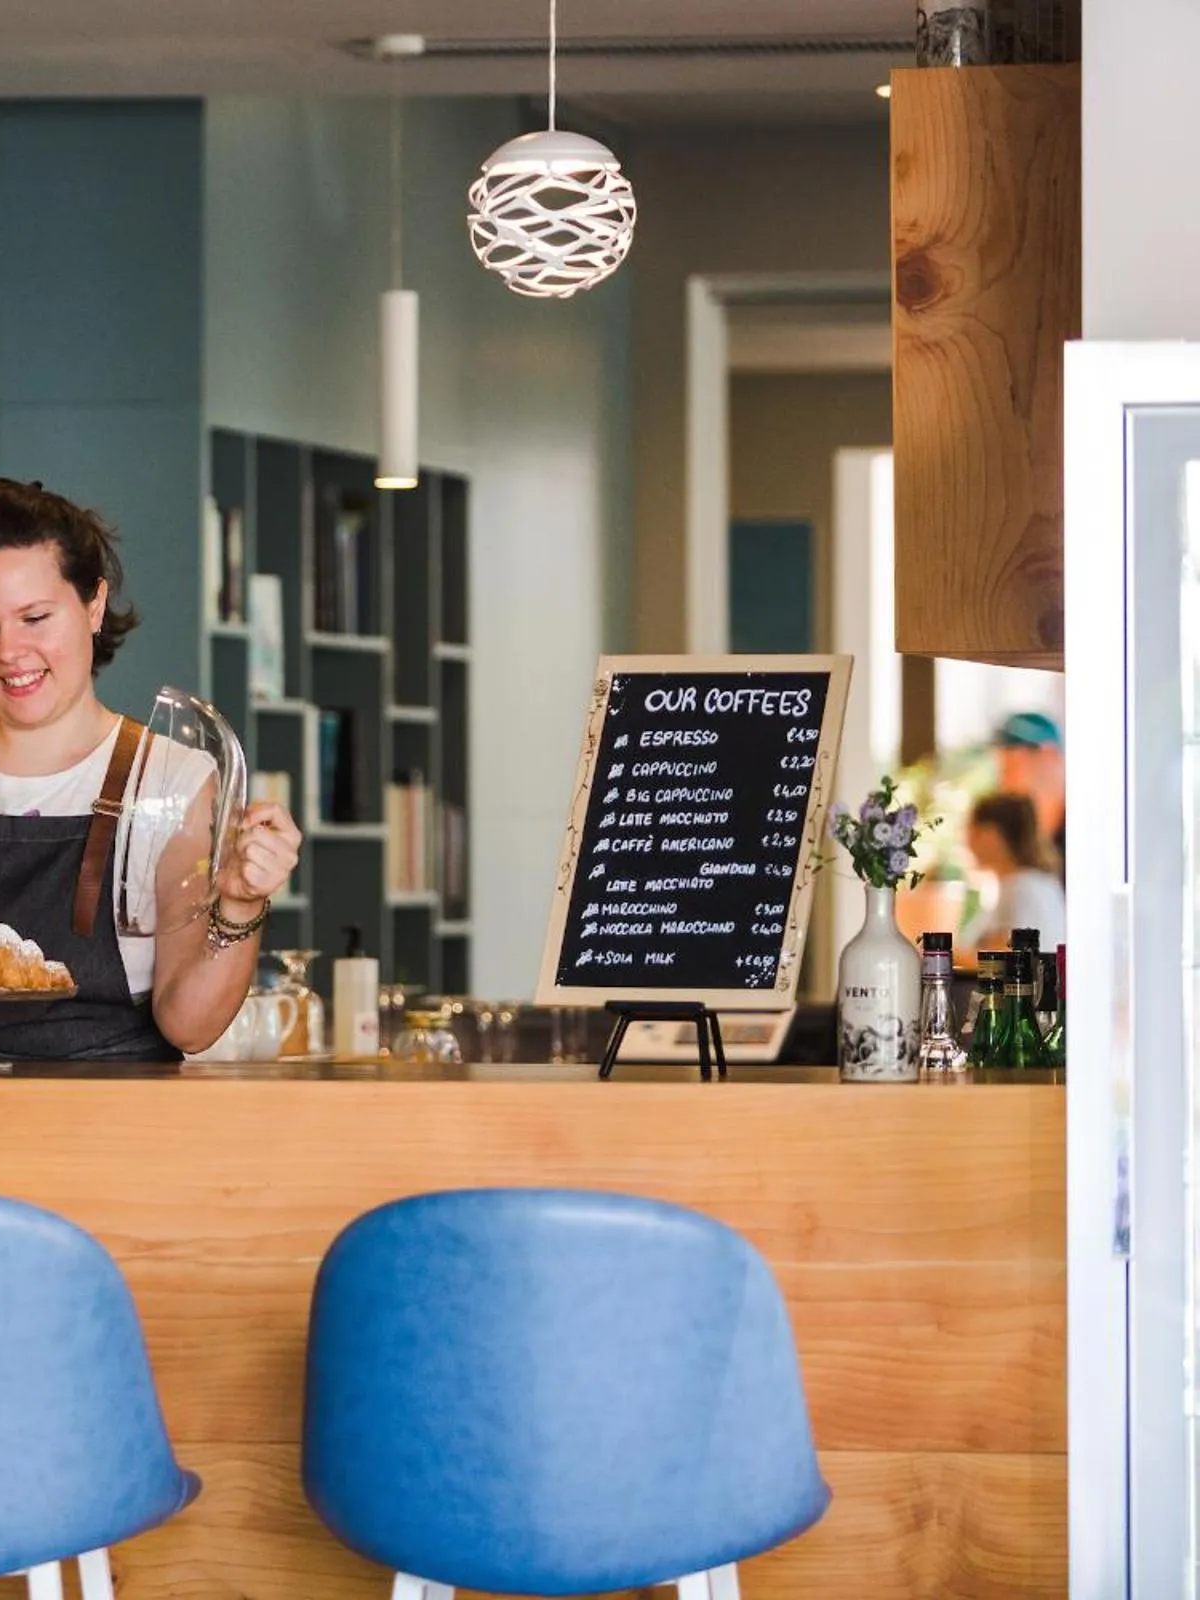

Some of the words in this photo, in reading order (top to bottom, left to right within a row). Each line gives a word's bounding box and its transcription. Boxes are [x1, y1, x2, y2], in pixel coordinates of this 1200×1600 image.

[644, 687, 696, 712] OUR
[704, 688, 811, 717] COFFEES
[640, 729, 719, 747] ESPRESSO
[632, 761, 717, 777] CAPPUCCINO
[626, 788, 650, 802] BIG
[655, 787, 733, 803] CAPPUCCINO
[619, 812, 652, 826] LATTE
[659, 812, 728, 825] MACCHIATO
[612, 835, 653, 852] CAFFÈ
[661, 837, 734, 852] AMERICANO
[606, 880, 637, 891] LATTE
[645, 877, 714, 891] MACCHIATO
[602, 902, 677, 915] MAROCCHINO
[600, 922, 652, 935] NOCCIOLA
[645, 953, 676, 964] MILK
[845, 986, 889, 998] VENTO
